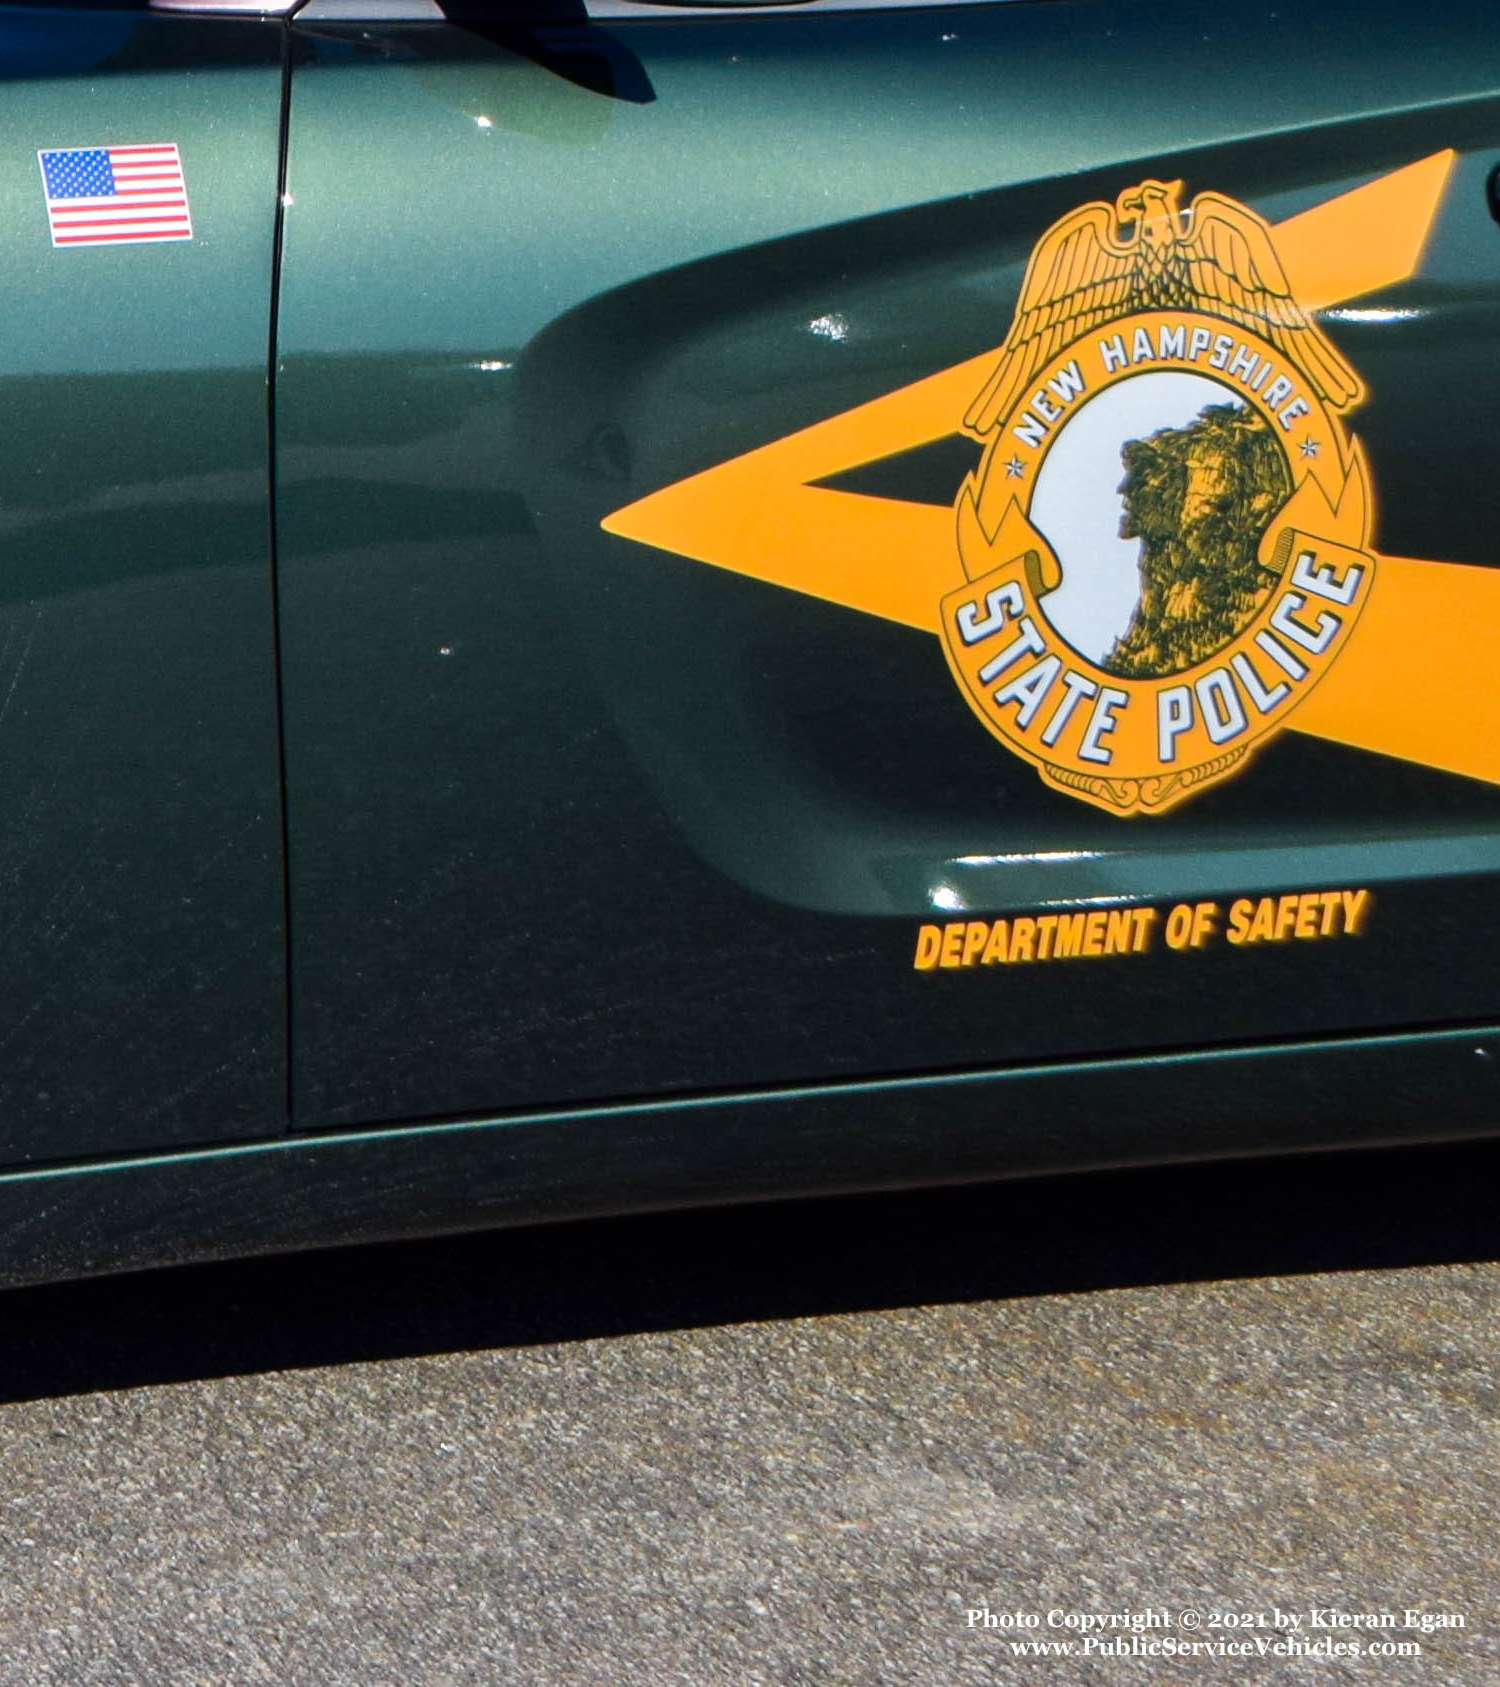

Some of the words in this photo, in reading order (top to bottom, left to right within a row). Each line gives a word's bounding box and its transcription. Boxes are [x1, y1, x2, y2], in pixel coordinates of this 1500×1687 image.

[1012, 360, 1084, 449] NEW
[1098, 324, 1310, 433] HAMPSHIRE
[955, 578, 1128, 764] STATE
[1156, 550, 1365, 762] POLICE
[913, 906, 1157, 972] DEPARTMENT
[1165, 901, 1218, 951] OF
[1226, 889, 1369, 946] SAFETY
